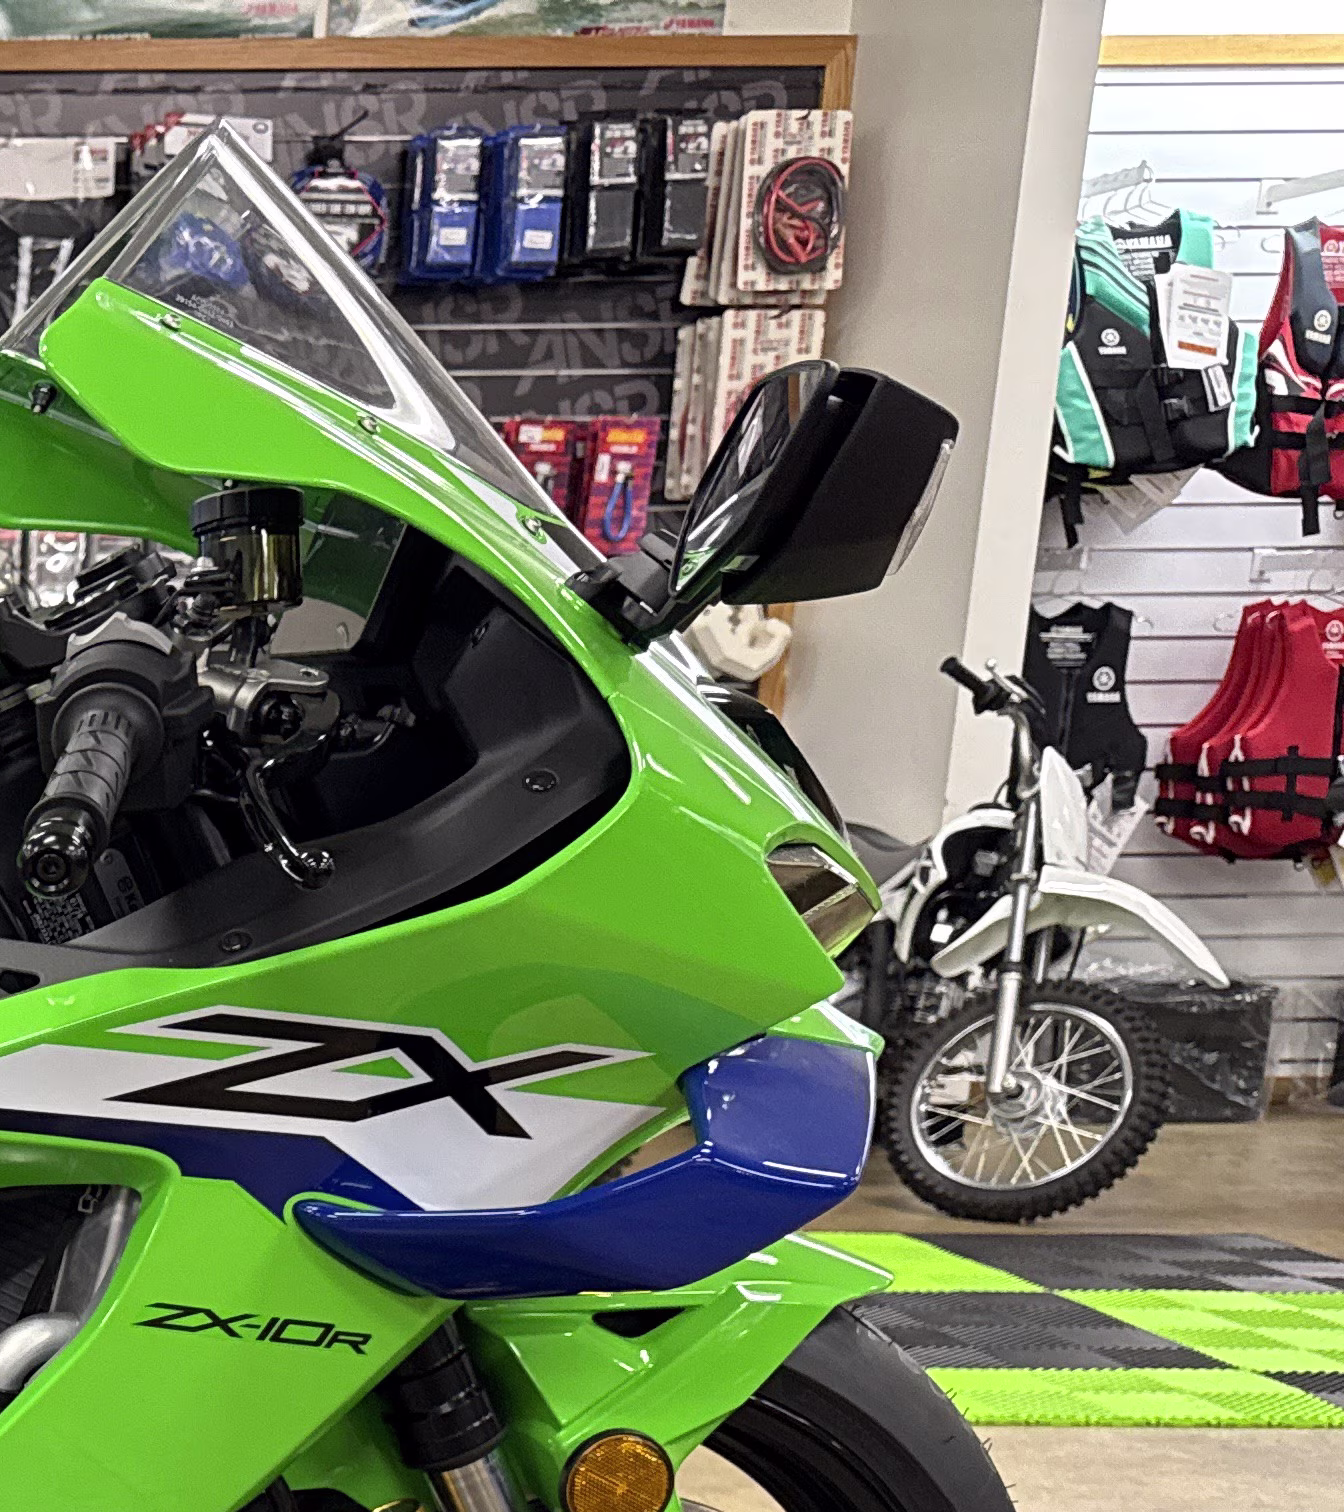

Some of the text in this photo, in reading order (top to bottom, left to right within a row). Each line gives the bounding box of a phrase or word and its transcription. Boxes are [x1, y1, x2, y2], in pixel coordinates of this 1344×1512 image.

[1125, 234, 1173, 250] YAMAHA
[103, 1012, 613, 1139] ZX
[132, 1301, 373, 1356] ZX-10R
